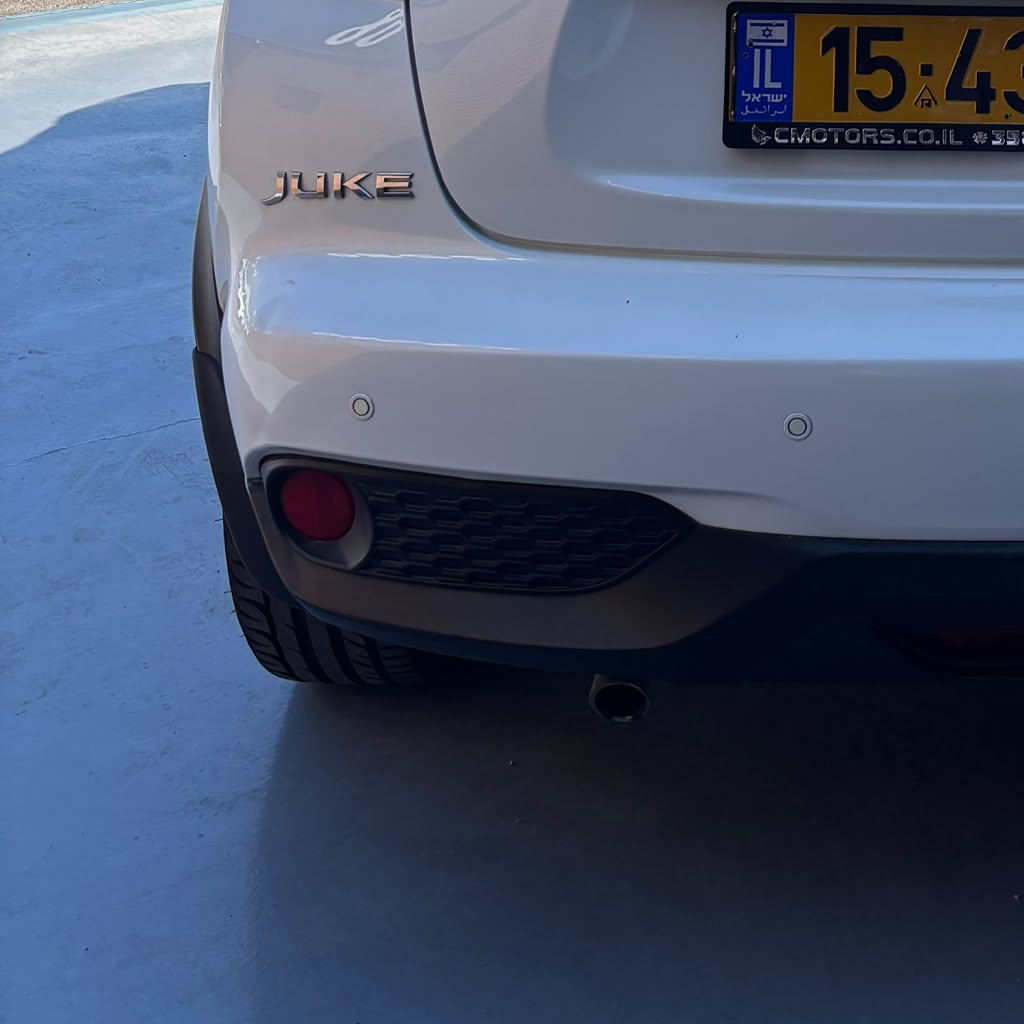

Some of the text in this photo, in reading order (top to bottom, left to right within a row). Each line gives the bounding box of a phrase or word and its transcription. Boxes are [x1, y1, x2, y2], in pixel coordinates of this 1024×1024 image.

[752, 48, 782, 89] IL
[741, 89, 787, 103] ישראל
[774, 127, 963, 146] CMOTORS.CO.IL
[260, 171, 415, 206] JUKE
